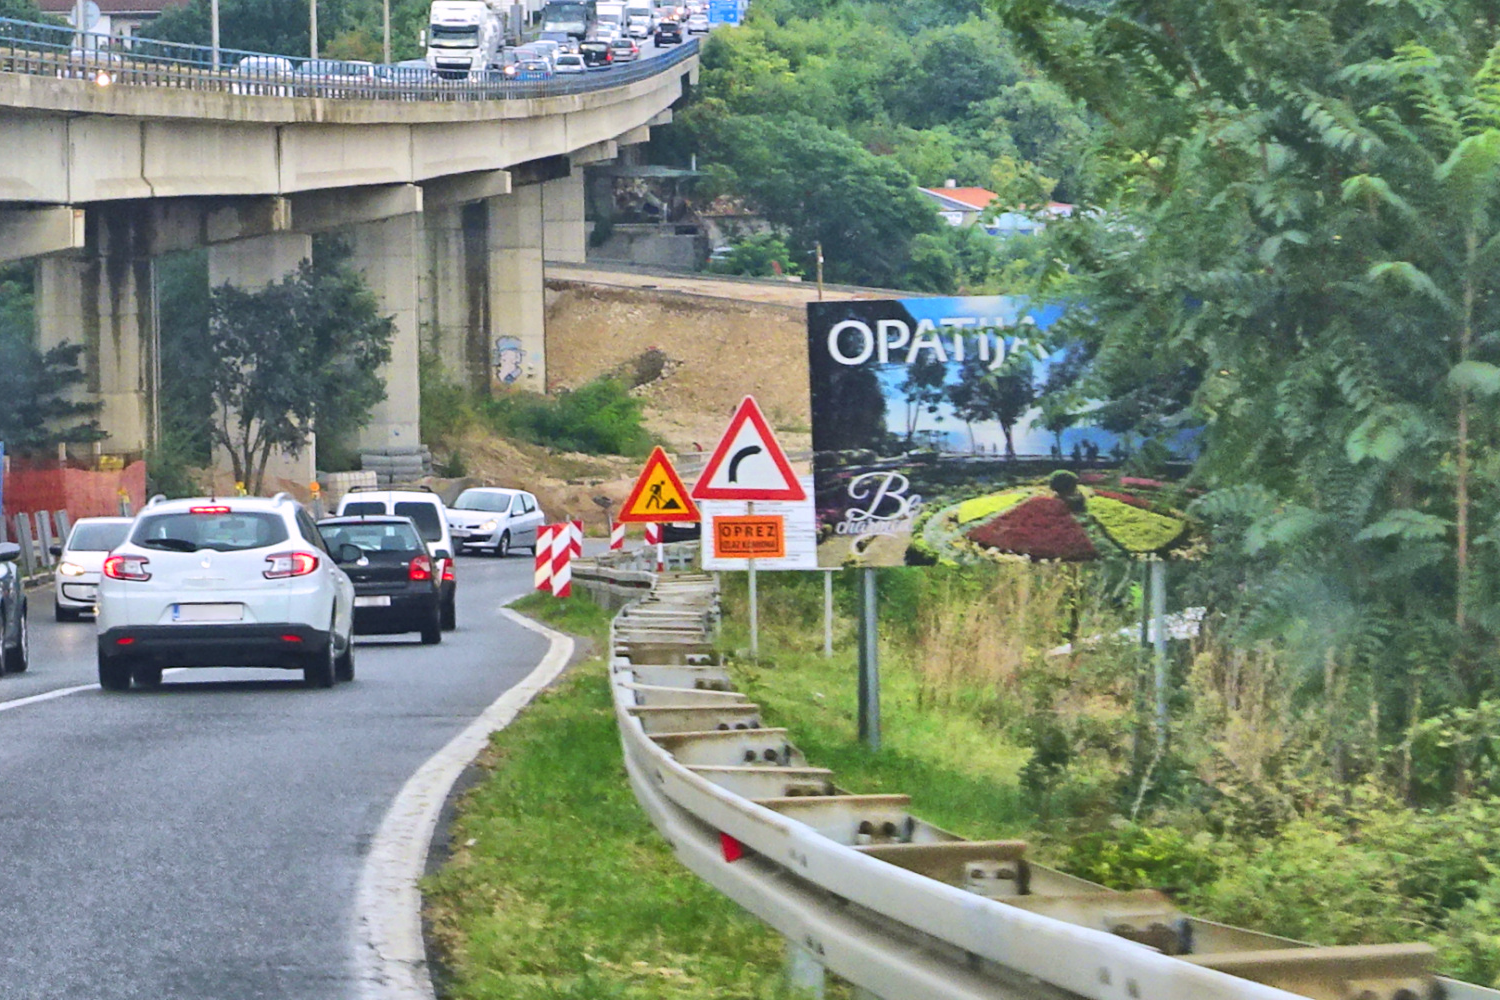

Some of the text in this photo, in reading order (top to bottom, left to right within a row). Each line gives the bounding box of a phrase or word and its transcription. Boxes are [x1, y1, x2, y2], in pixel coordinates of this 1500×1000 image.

[828, 316, 1049, 371] OPATIJA
[845, 471, 922, 521] Be
[721, 525, 776, 537] OPREZ
